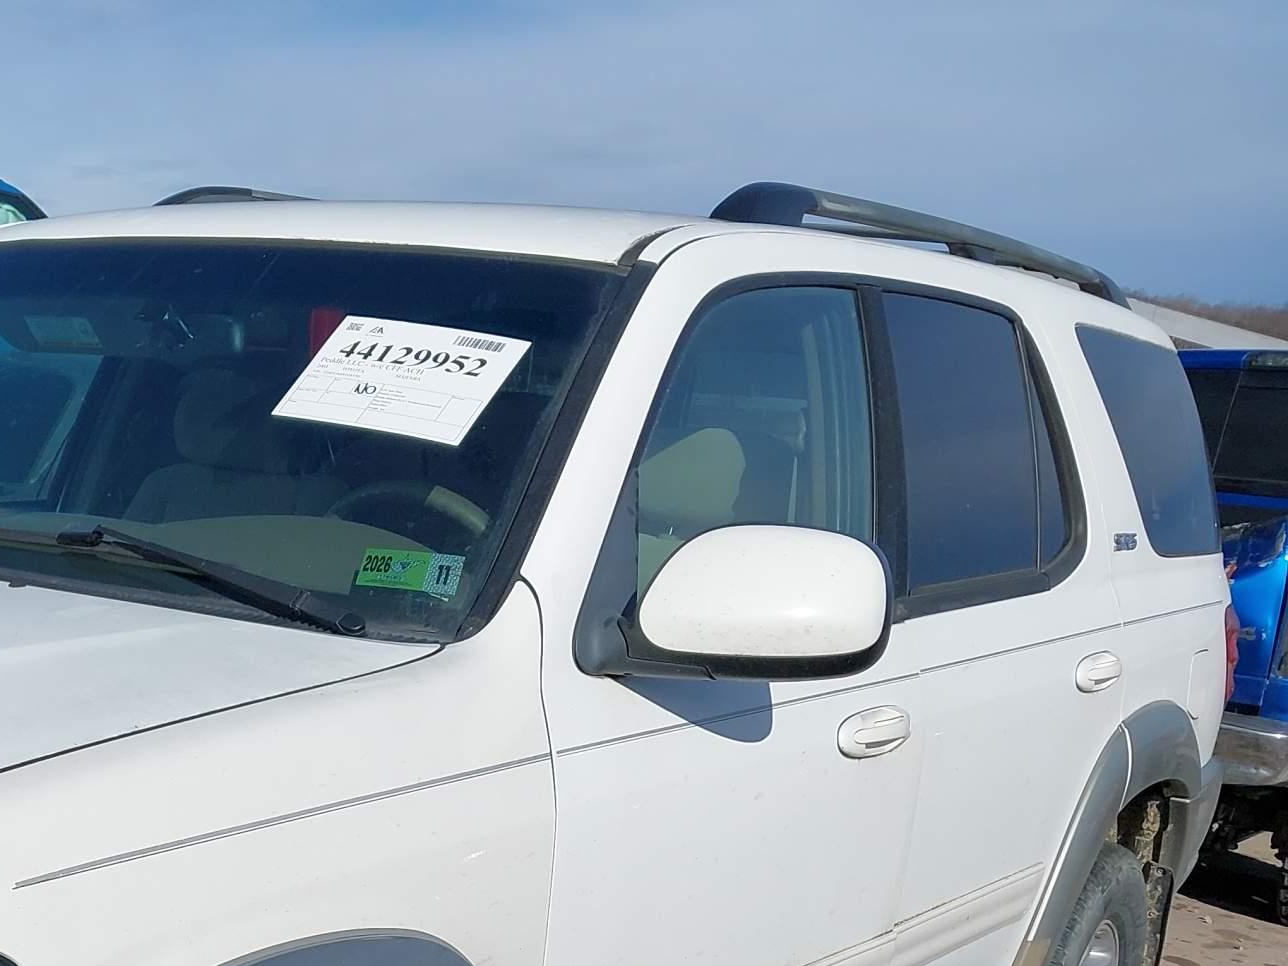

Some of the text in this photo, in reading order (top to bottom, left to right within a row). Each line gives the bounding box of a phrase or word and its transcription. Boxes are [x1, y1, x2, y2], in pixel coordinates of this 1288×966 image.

[339, 340, 488, 377] 44129952
[362, 555, 393, 573] 2026
[435, 564, 451, 586] 11
